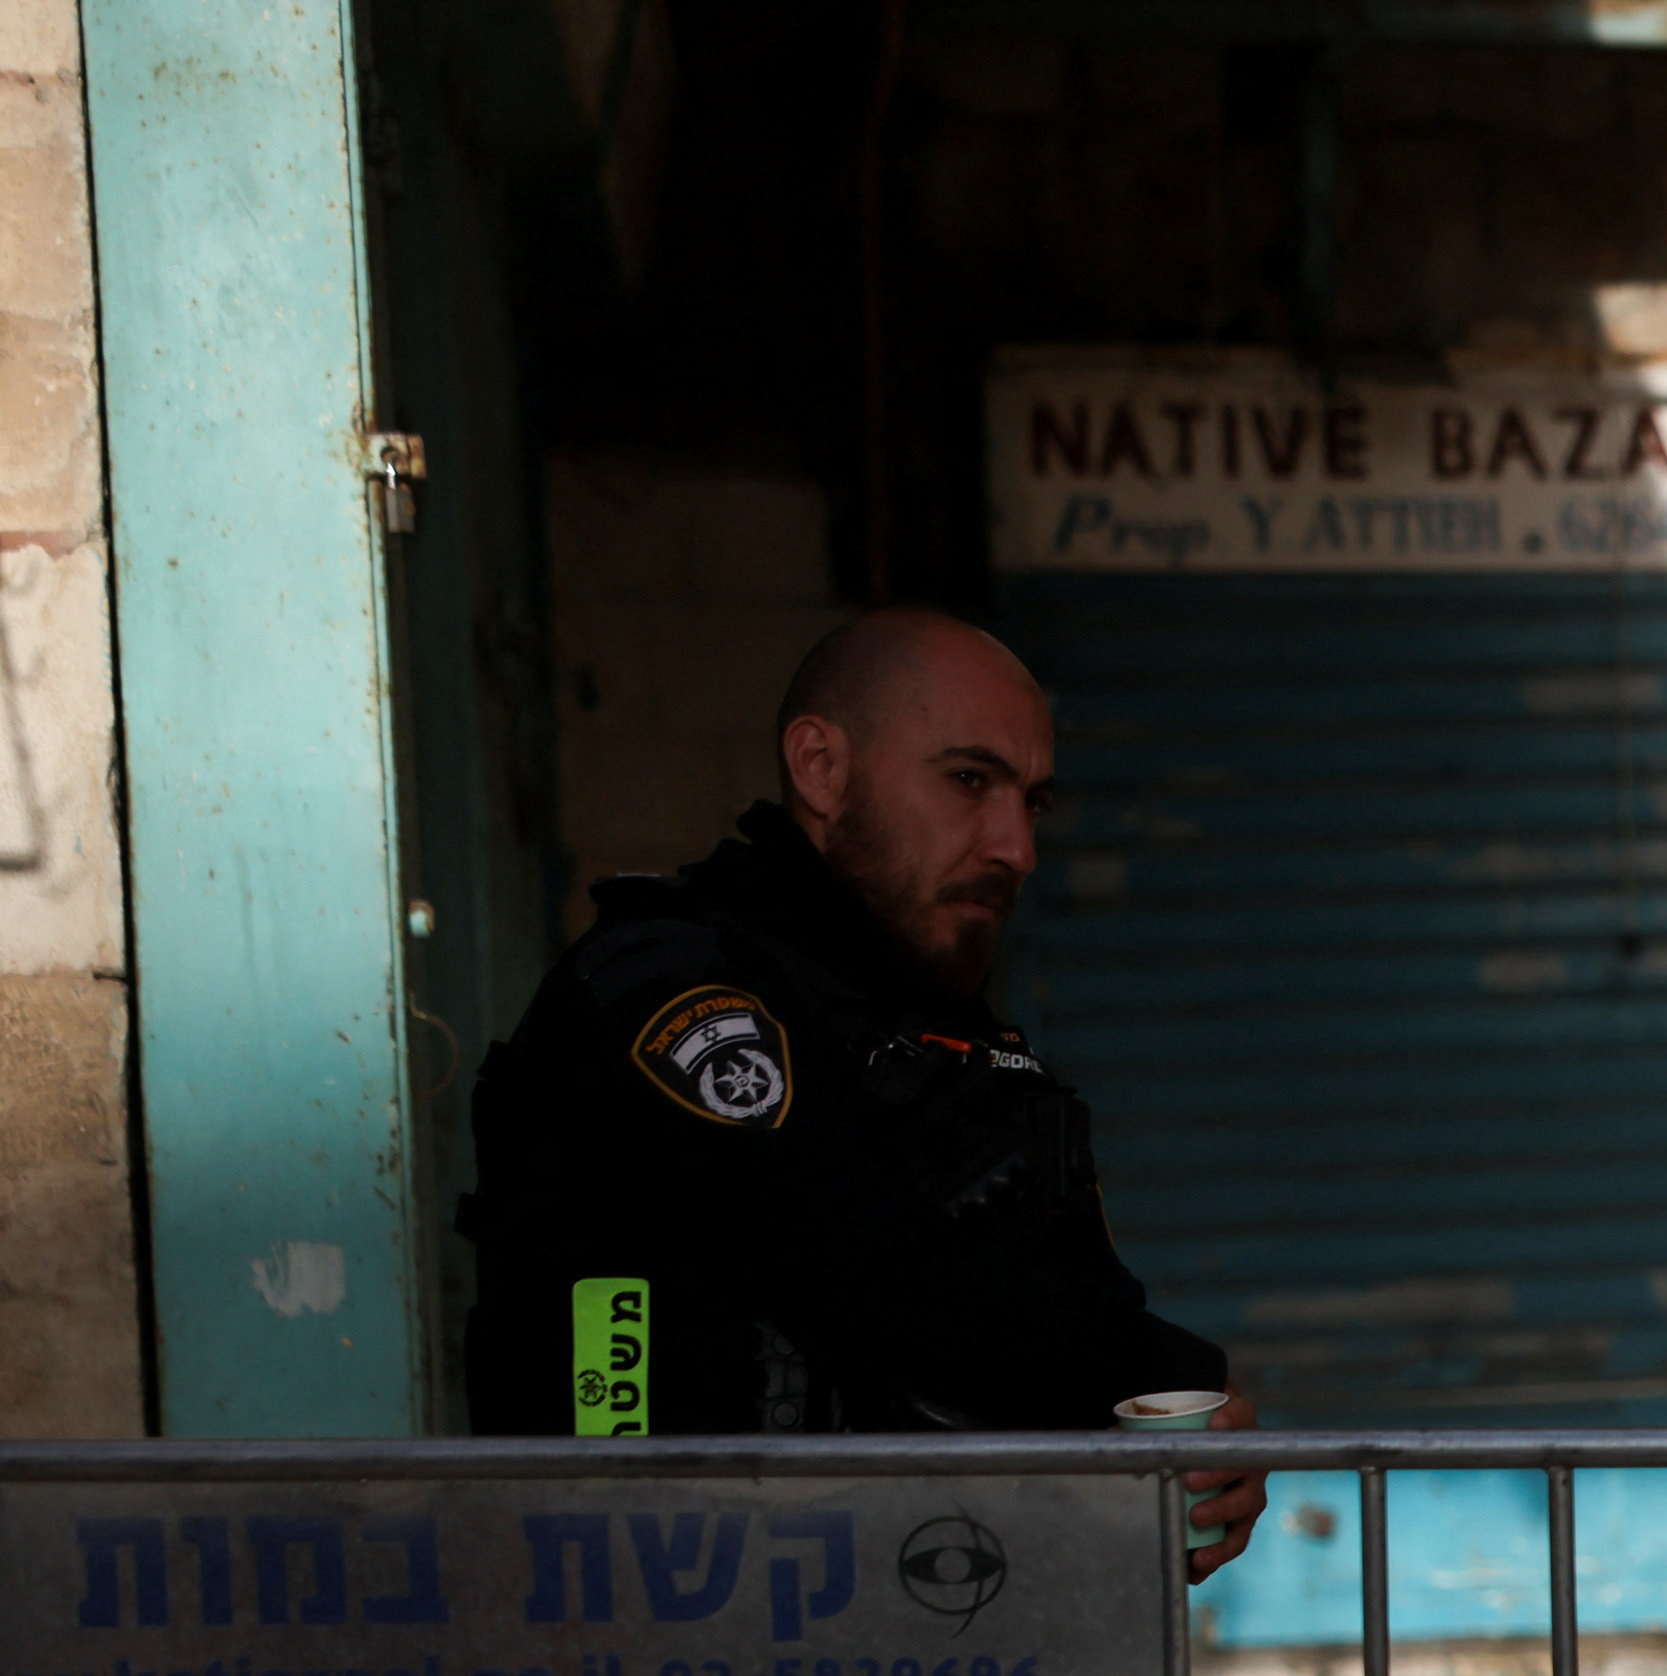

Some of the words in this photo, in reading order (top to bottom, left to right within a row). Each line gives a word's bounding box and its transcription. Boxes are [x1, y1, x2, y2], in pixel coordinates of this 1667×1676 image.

[1031, 401, 1370, 481] NATIVE
[610, 1291, 642, 1437] משטר
[76, 1514, 450, 1627] במות
[523, 1510, 857, 1642] קשת
